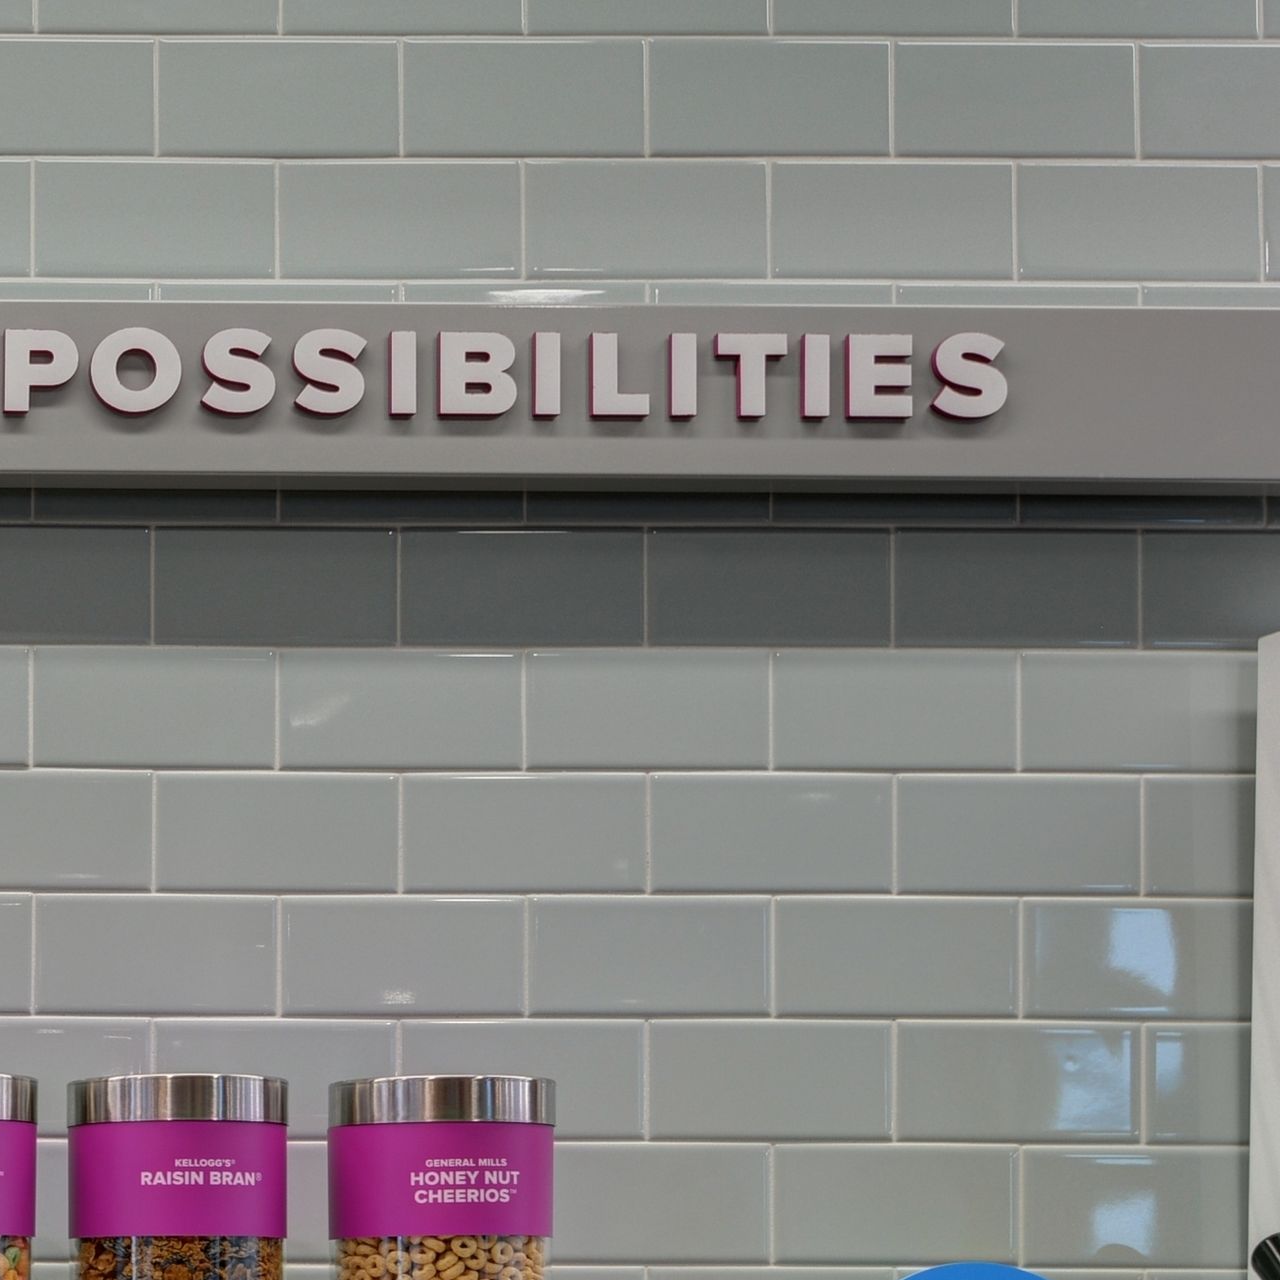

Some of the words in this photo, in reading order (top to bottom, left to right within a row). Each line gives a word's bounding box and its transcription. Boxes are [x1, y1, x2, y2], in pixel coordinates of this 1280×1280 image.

[2, 327, 1009, 421] POSSIBILITIES
[424, 1158, 477, 1168] GENERAL
[478, 1157, 508, 1167] MILLS
[140, 1170, 204, 1186] RAISIN
[410, 1170, 480, 1186] HONEY
[484, 1170, 521, 1185] NUT
